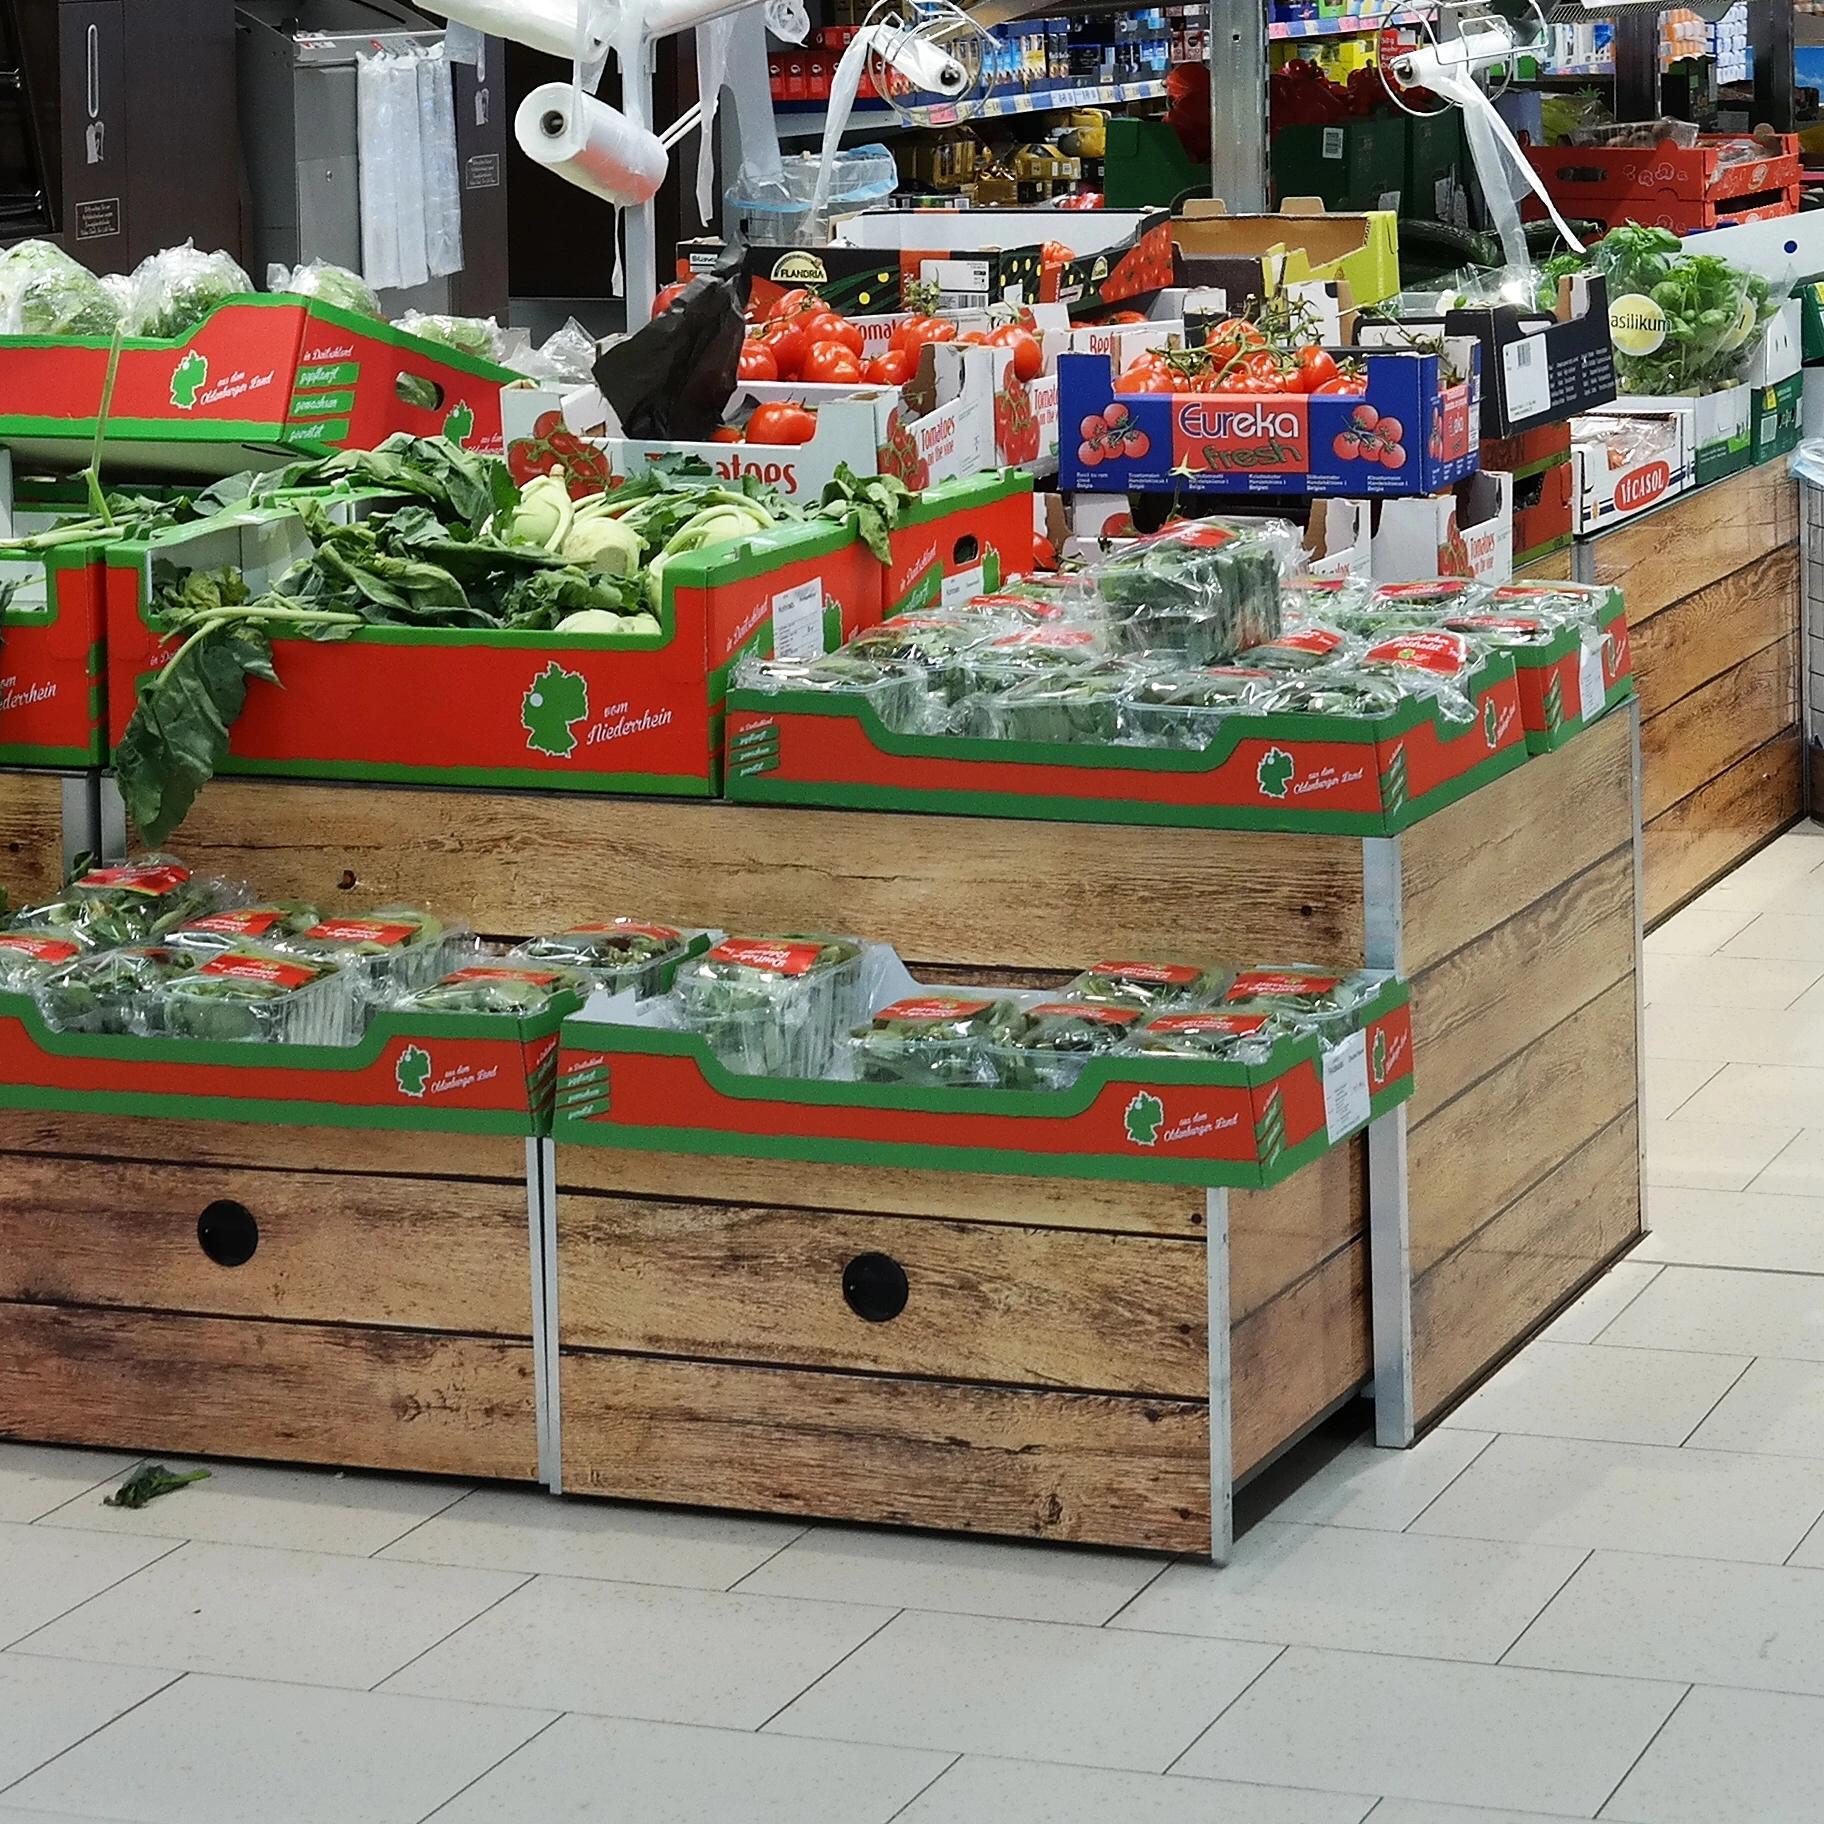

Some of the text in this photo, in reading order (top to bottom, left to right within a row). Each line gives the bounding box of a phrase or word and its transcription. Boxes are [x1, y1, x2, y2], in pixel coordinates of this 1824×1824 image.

[780, 267, 825, 281] FLANDRIA
[1610, 312, 1672, 333] asilikum
[921, 414, 957, 455] Tomatoes
[1178, 402, 1299, 440] Eureka
[1202, 438, 1305, 473] fresh
[603, 699, 629, 718] vom
[586, 708, 673, 746] Niederrhein
